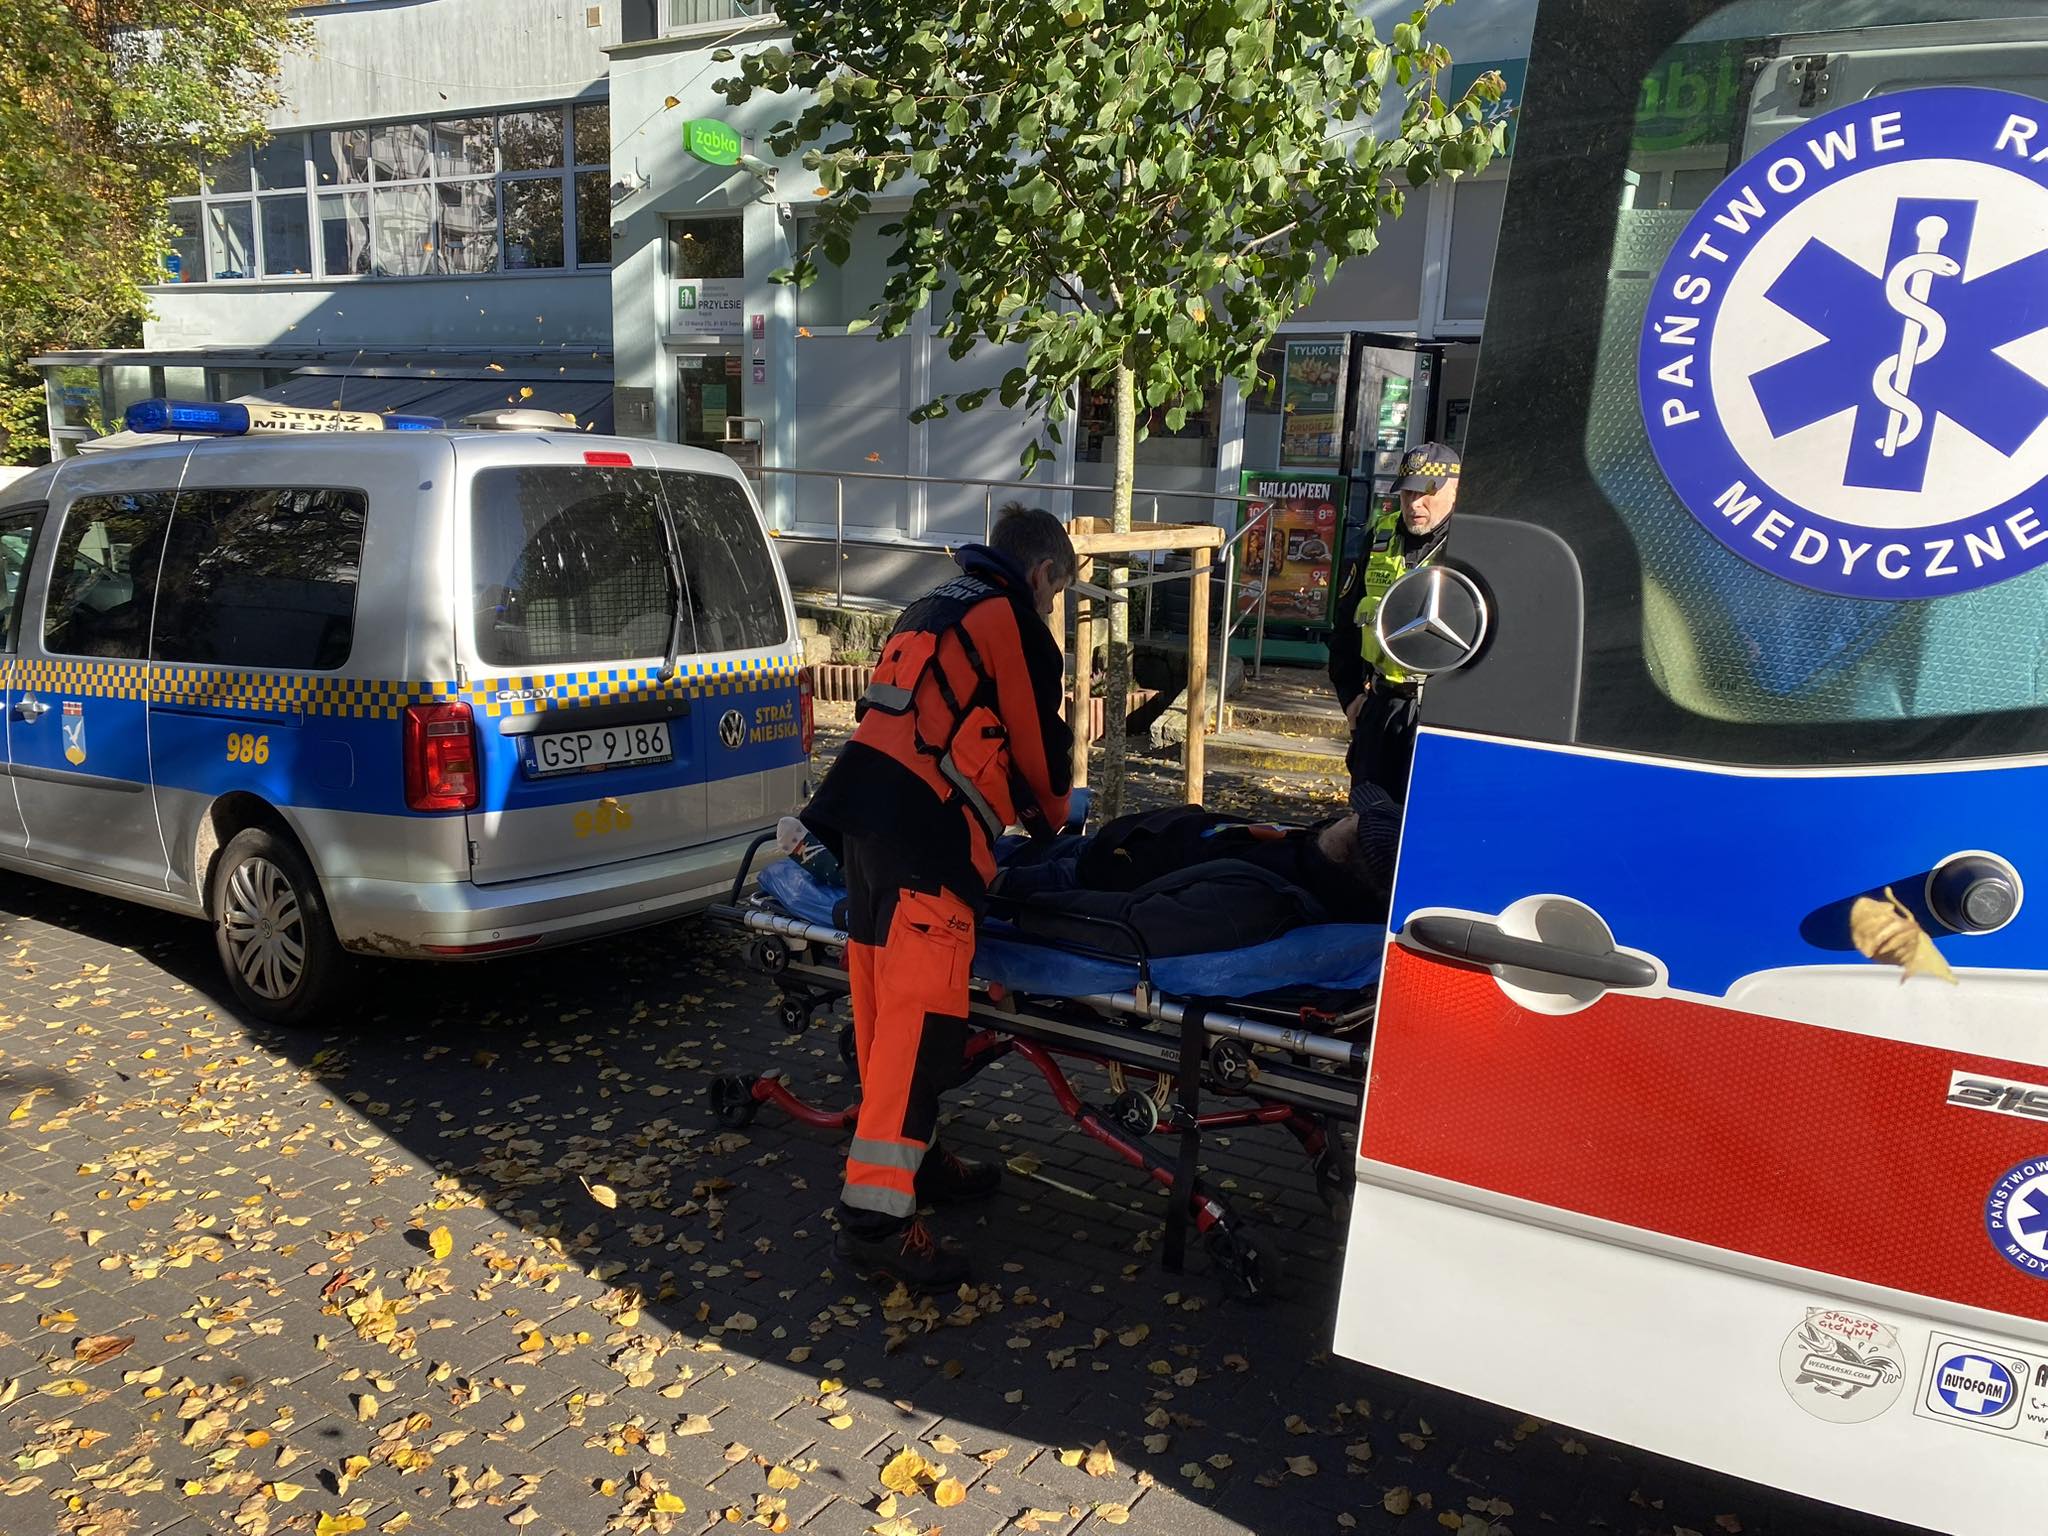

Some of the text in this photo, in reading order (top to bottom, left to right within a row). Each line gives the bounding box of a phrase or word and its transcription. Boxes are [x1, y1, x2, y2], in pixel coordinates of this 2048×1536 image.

[696, 126, 737, 153] żabka
[1655, 111, 1905, 427] PAŃSTWOWE
[698, 300, 741, 310] PRZYLESIE
[1294, 346, 1327, 355] TYLKO
[270, 410, 364, 424] STRAŻ
[1259, 482, 1331, 501] HALLOWEEN
[1713, 479, 2048, 580] MEDYCZNE
[497, 688, 553, 701] CADDY
[756, 698, 793, 724] STRAŻ
[750, 721, 799, 744] MIEJSKA
[226, 733, 269, 765] 986
[542, 735, 593, 767] GSP
[526, 759, 537, 768] PL
[1824, 1312, 1879, 1332] SPONSOR
[1944, 1373, 2003, 1398] AUTOFORM
